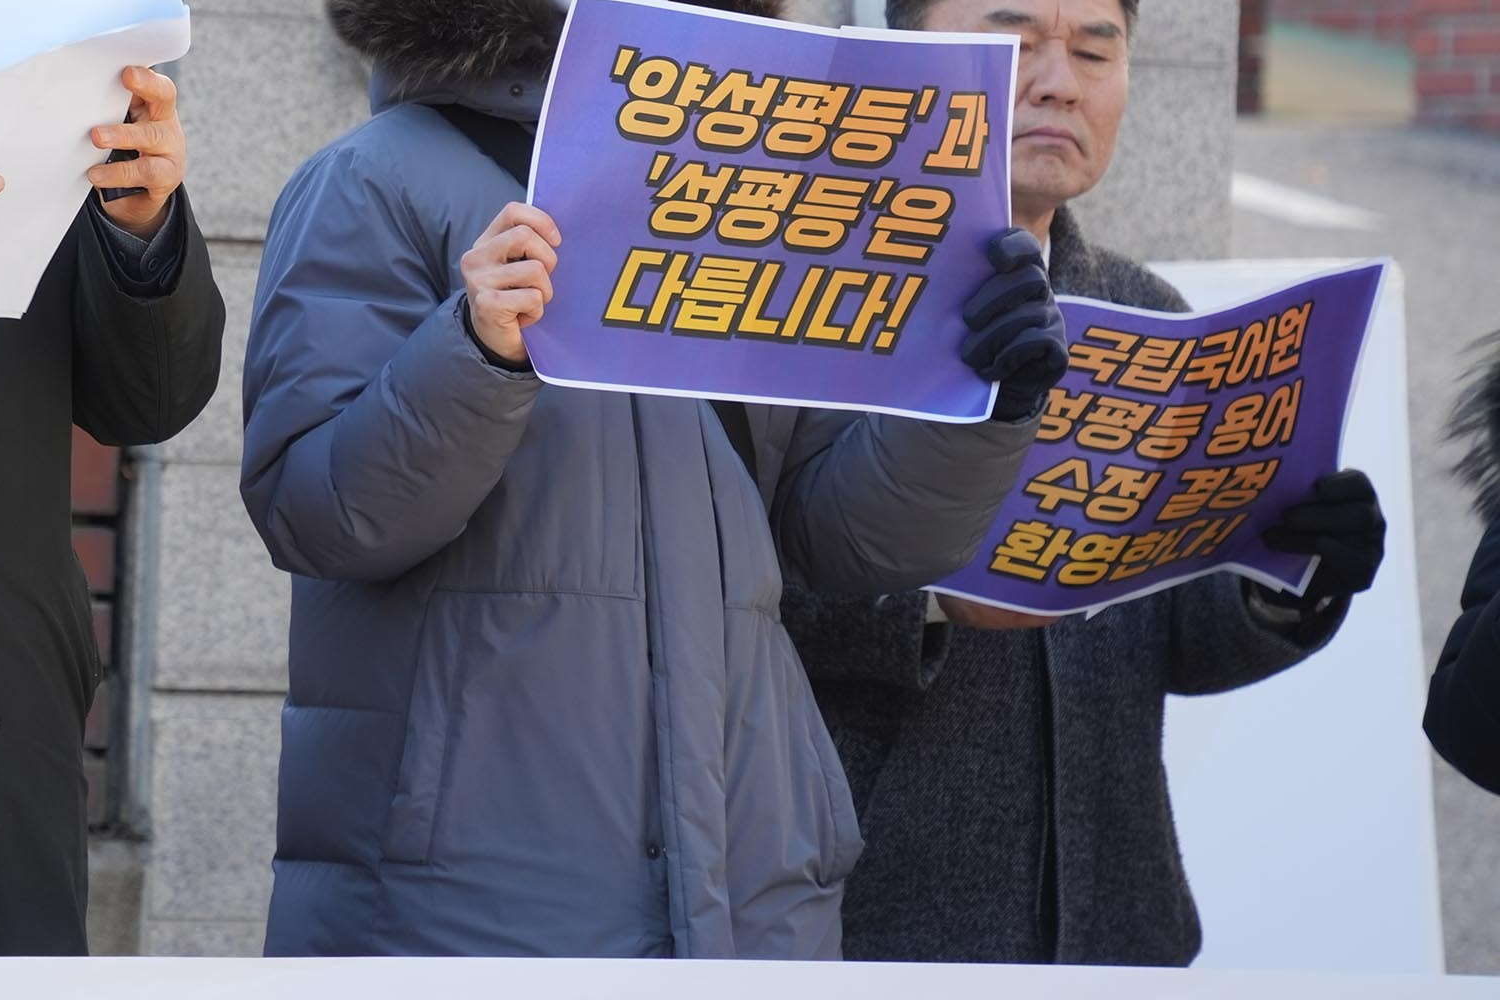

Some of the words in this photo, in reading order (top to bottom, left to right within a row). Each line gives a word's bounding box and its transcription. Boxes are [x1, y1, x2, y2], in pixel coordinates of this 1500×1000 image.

[611, 45, 938, 168] '양성평등'
[922, 92, 989, 176] 과
[646, 152, 955, 264] '성평등'은
[602, 247, 929, 355] 다릅니다!
[1067, 301, 1313, 394] 국립국어원
[1204, 378, 1303, 457] 용어
[1023, 457, 1164, 523] 수정
[1155, 458, 1281, 522] 결정
[988, 512, 1249, 587] 환영한다!
